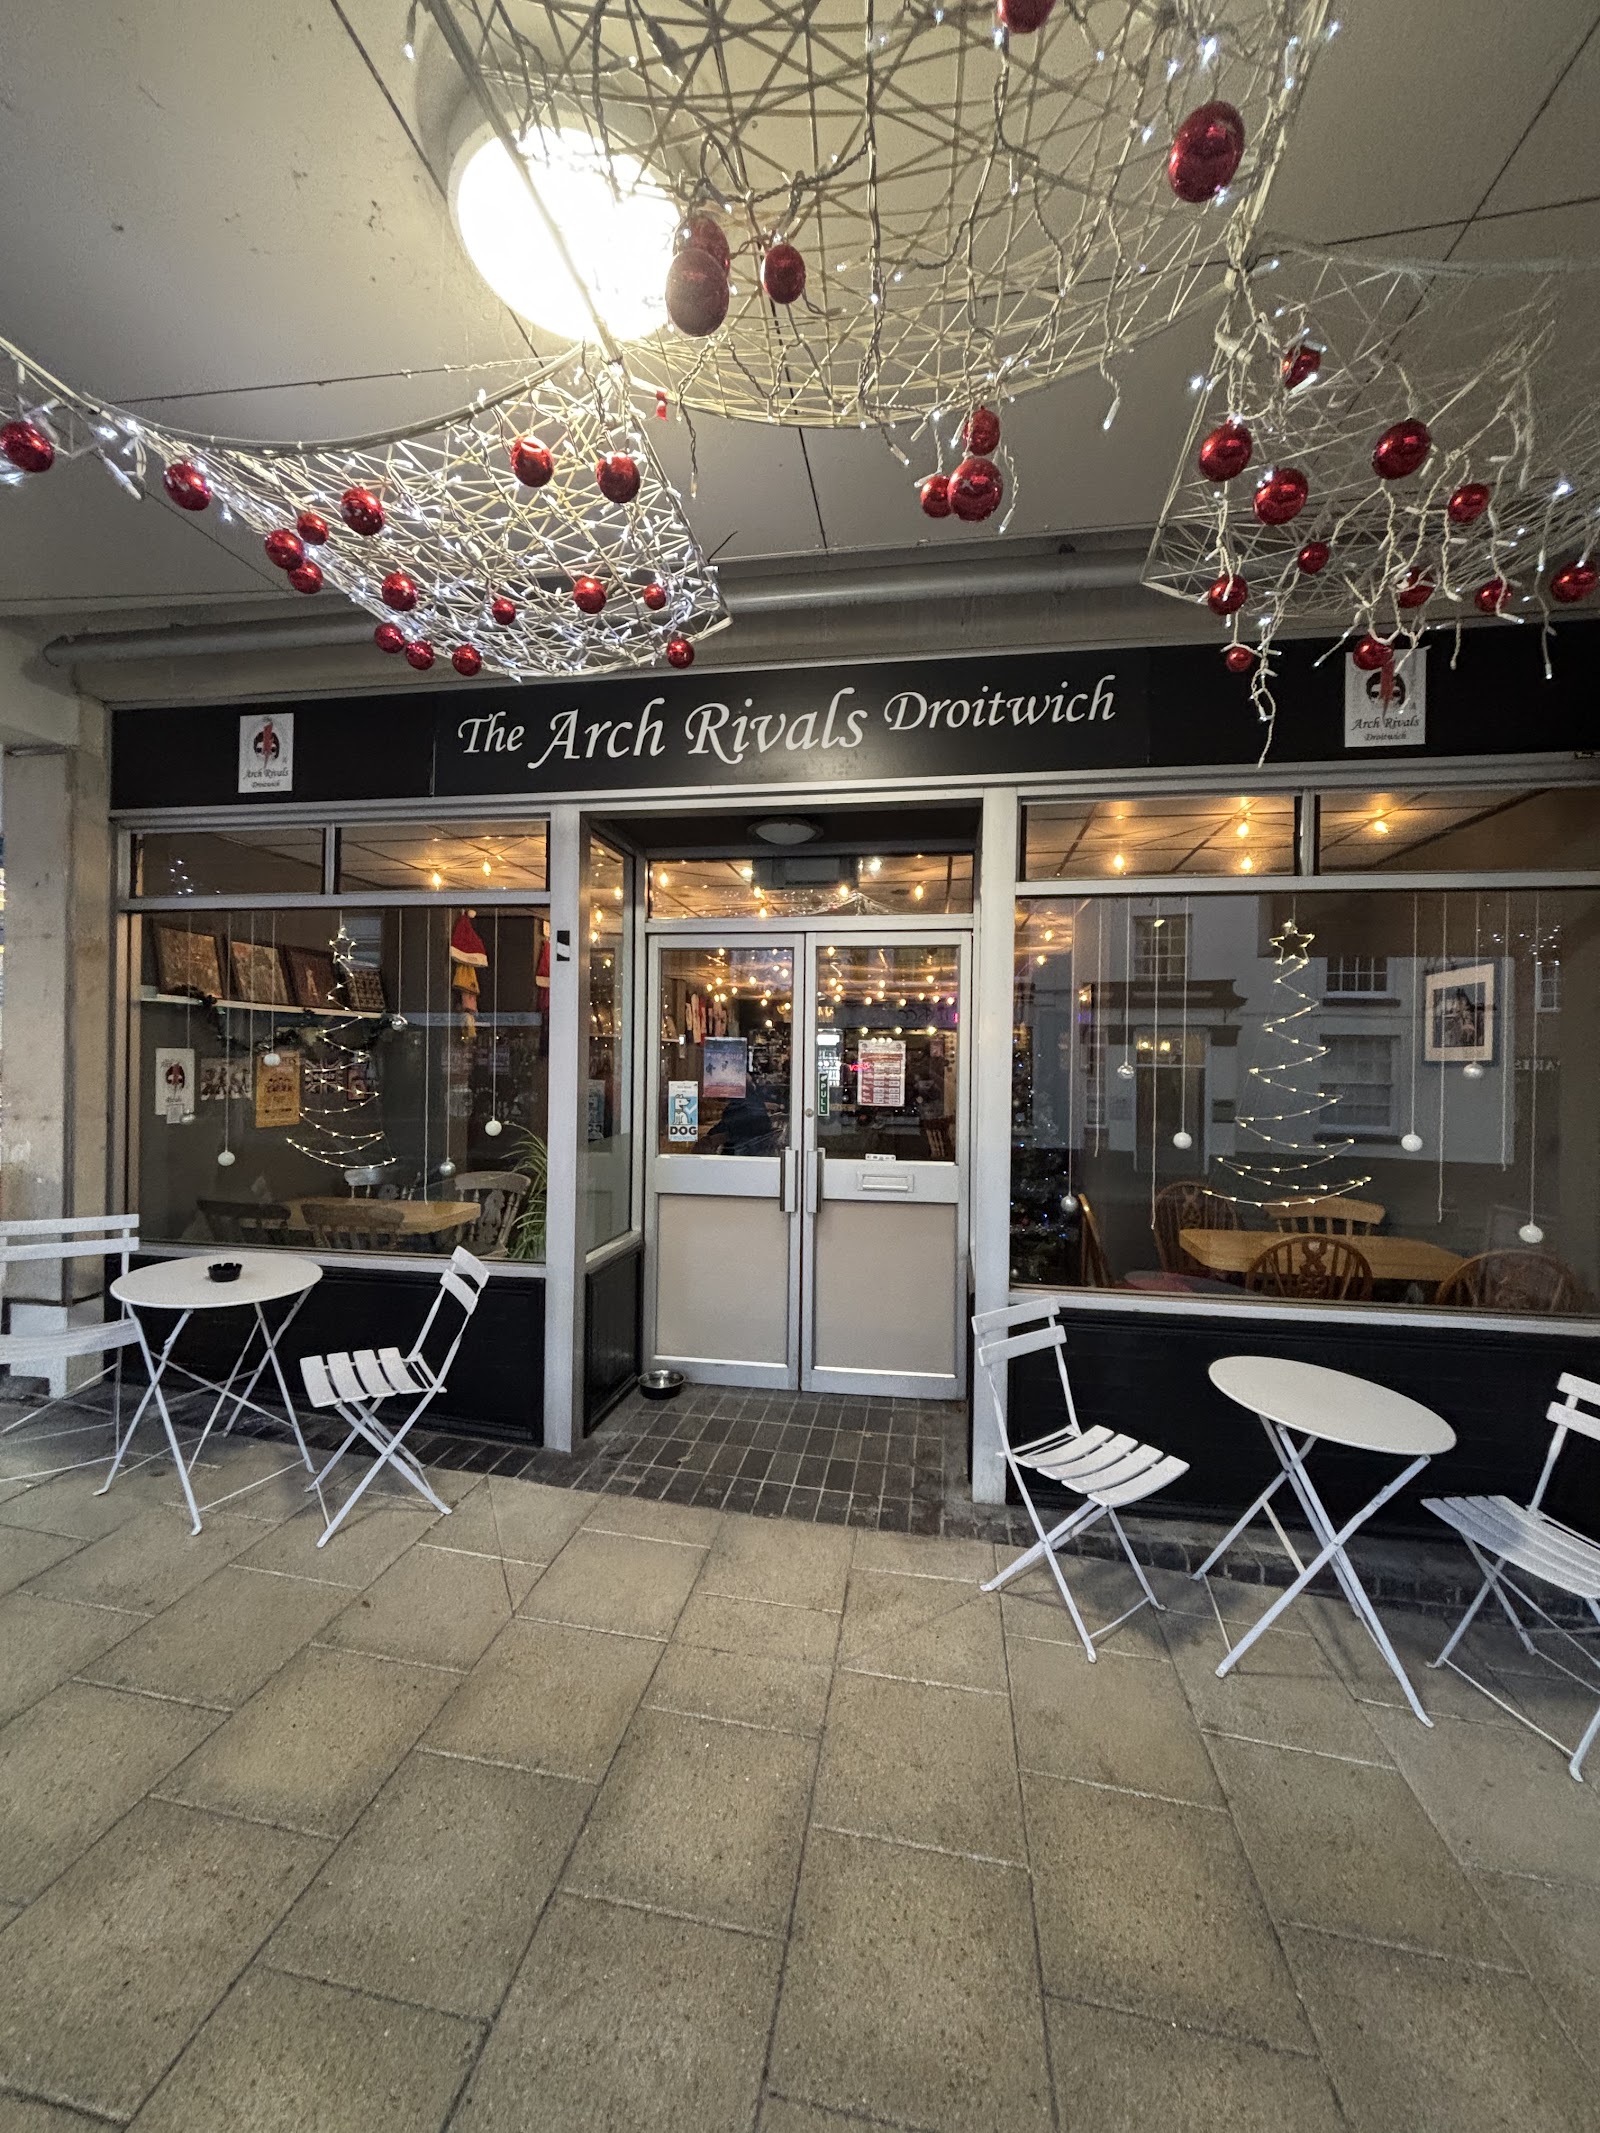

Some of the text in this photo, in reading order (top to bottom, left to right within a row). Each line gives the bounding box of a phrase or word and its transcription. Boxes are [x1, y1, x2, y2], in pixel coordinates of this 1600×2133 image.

[457, 674, 1117, 770] The Arch Rivals Droitwich
[1351, 715, 1419, 730] Arch Rivals
[243, 767, 288, 779] Arch Rivals
[670, 1126, 697, 1136] DOG
